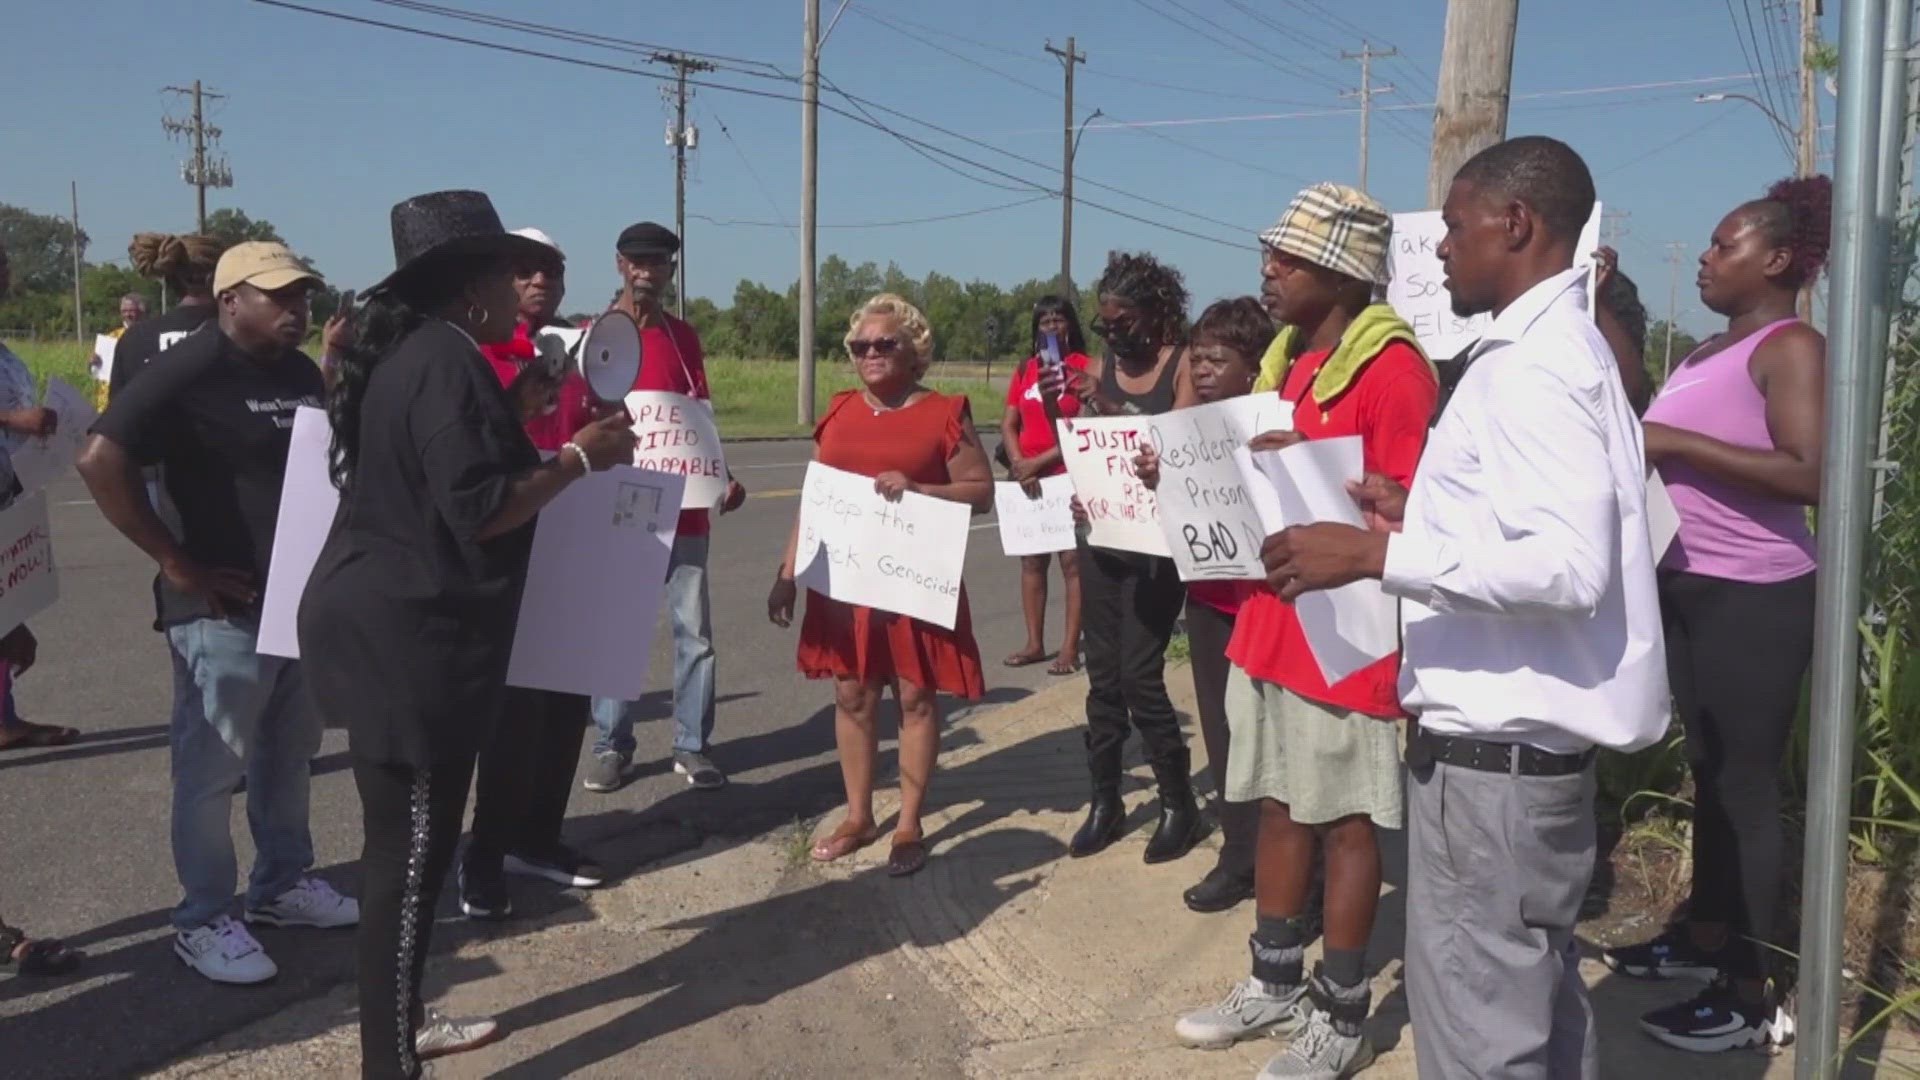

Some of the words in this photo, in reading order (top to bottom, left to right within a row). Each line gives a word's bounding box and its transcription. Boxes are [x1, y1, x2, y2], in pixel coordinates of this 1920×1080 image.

[1392, 229, 1440, 256] Tak
[1076, 428, 1142, 453] JUSTI
[809, 477, 863, 526] Stop
[873, 505, 916, 536] the
[1182, 520, 1238, 562] BAD
[876, 553, 960, 598] Genocide
